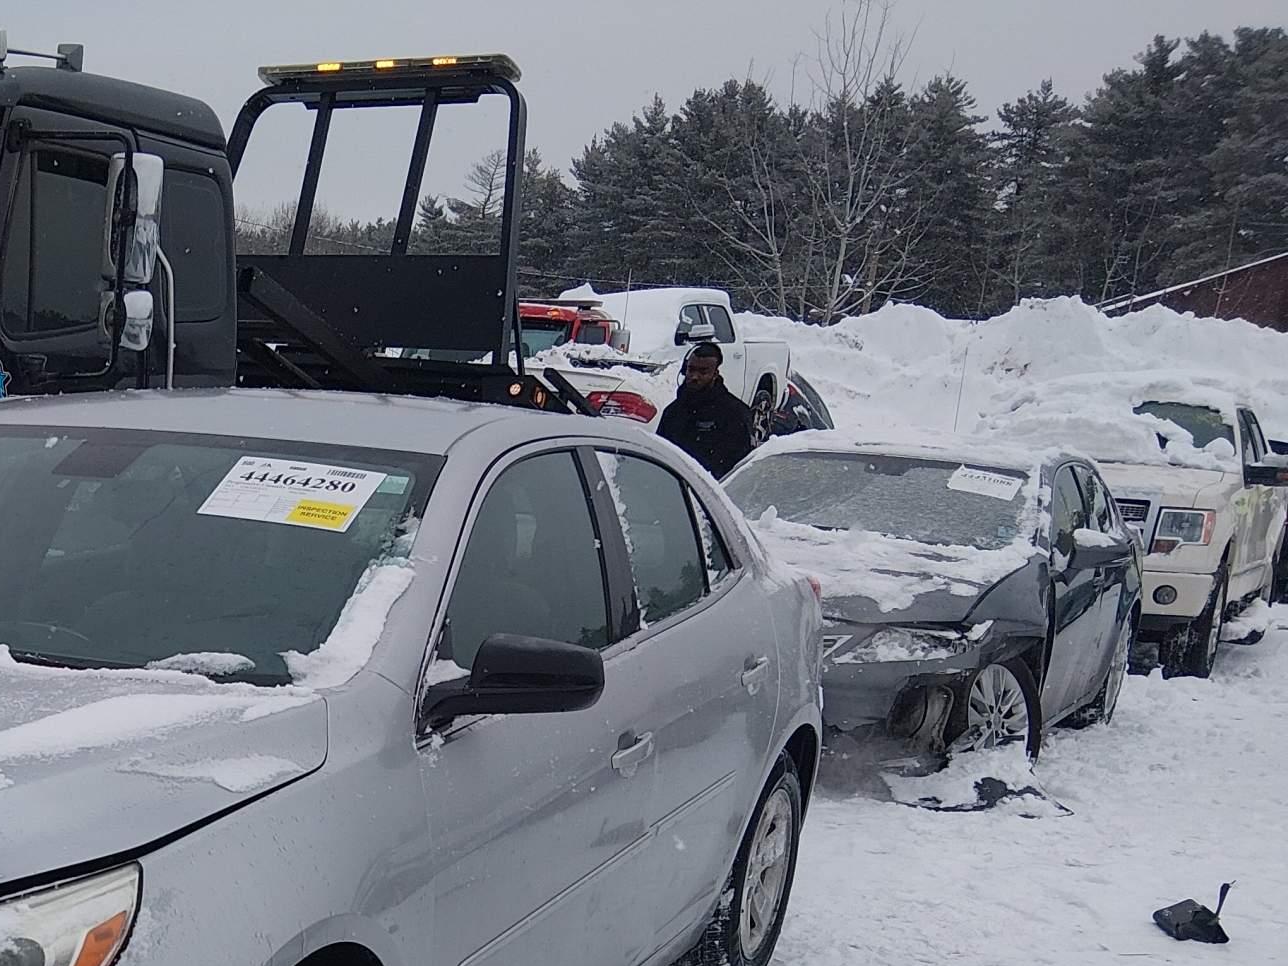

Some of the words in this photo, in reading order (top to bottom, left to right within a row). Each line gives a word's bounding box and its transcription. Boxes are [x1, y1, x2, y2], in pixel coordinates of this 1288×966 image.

[239, 470, 357, 493] 44464280
[297, 504, 349, 517] INSPECTION
[299, 511, 337, 521] SERVICE
